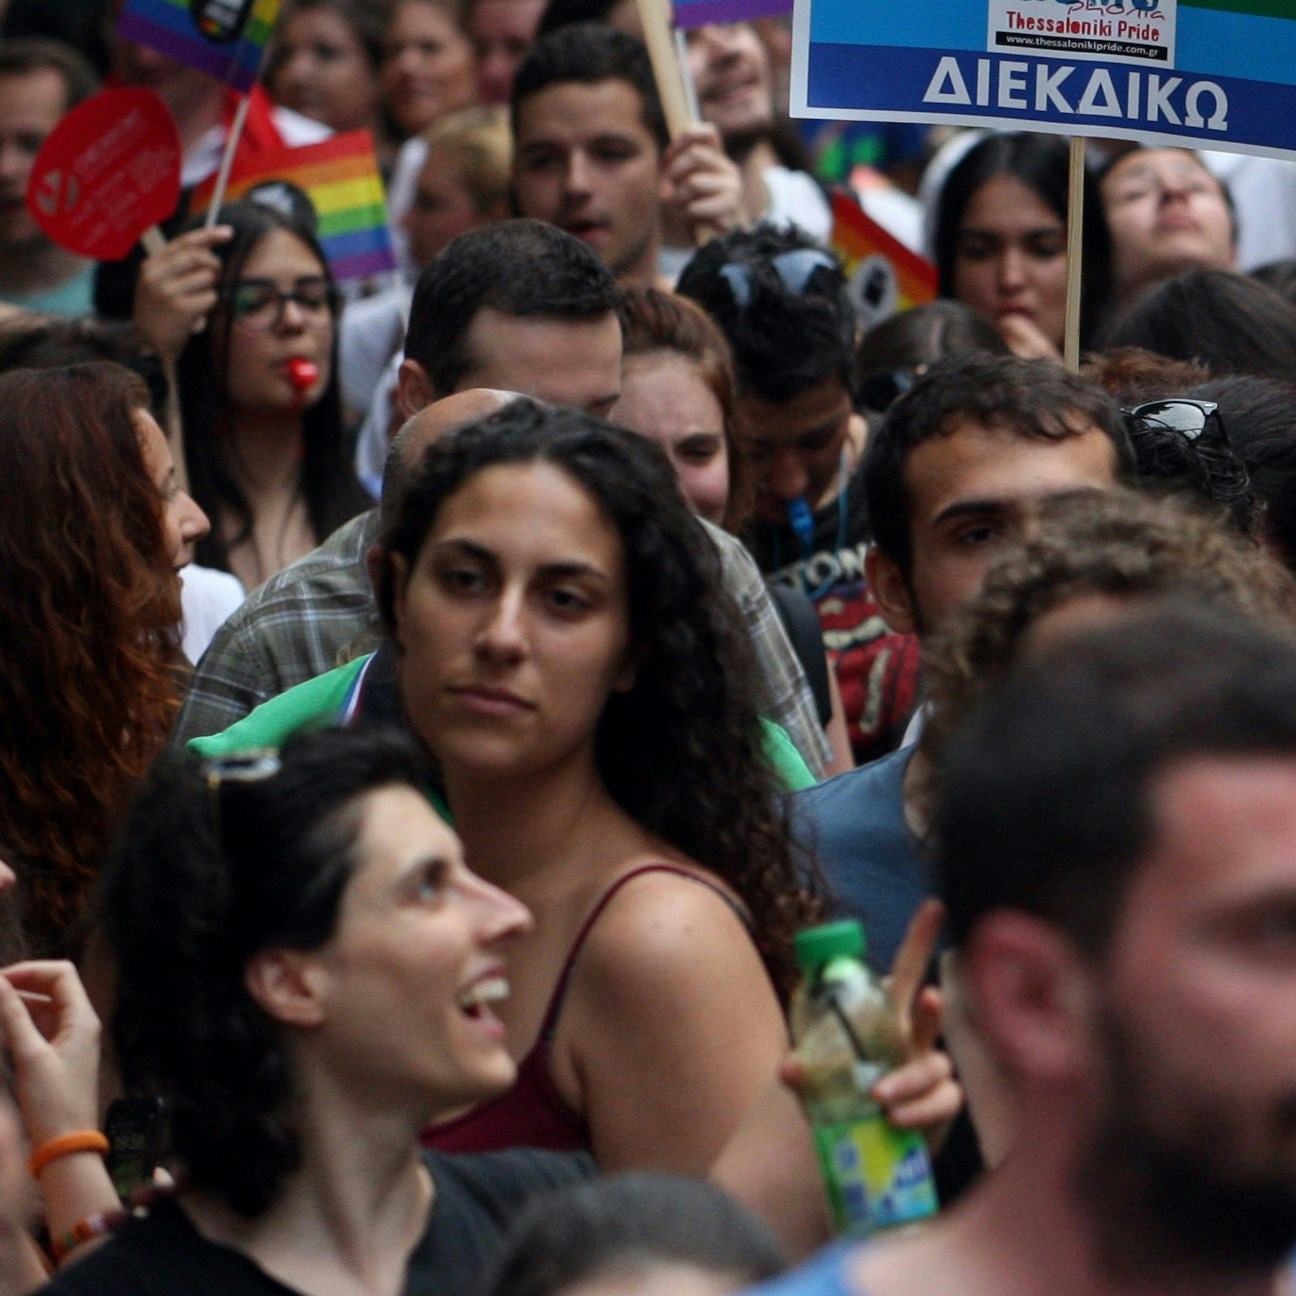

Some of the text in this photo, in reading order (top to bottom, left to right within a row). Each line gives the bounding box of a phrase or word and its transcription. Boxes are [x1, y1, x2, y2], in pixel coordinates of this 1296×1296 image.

[1006, 10, 1161, 42] Thessaloniki Pride
[1005, 34, 1160, 58] www.thessalonikipride.com.gr
[922, 55, 1229, 132] ΔΙΕΚΔΙΚΩ
